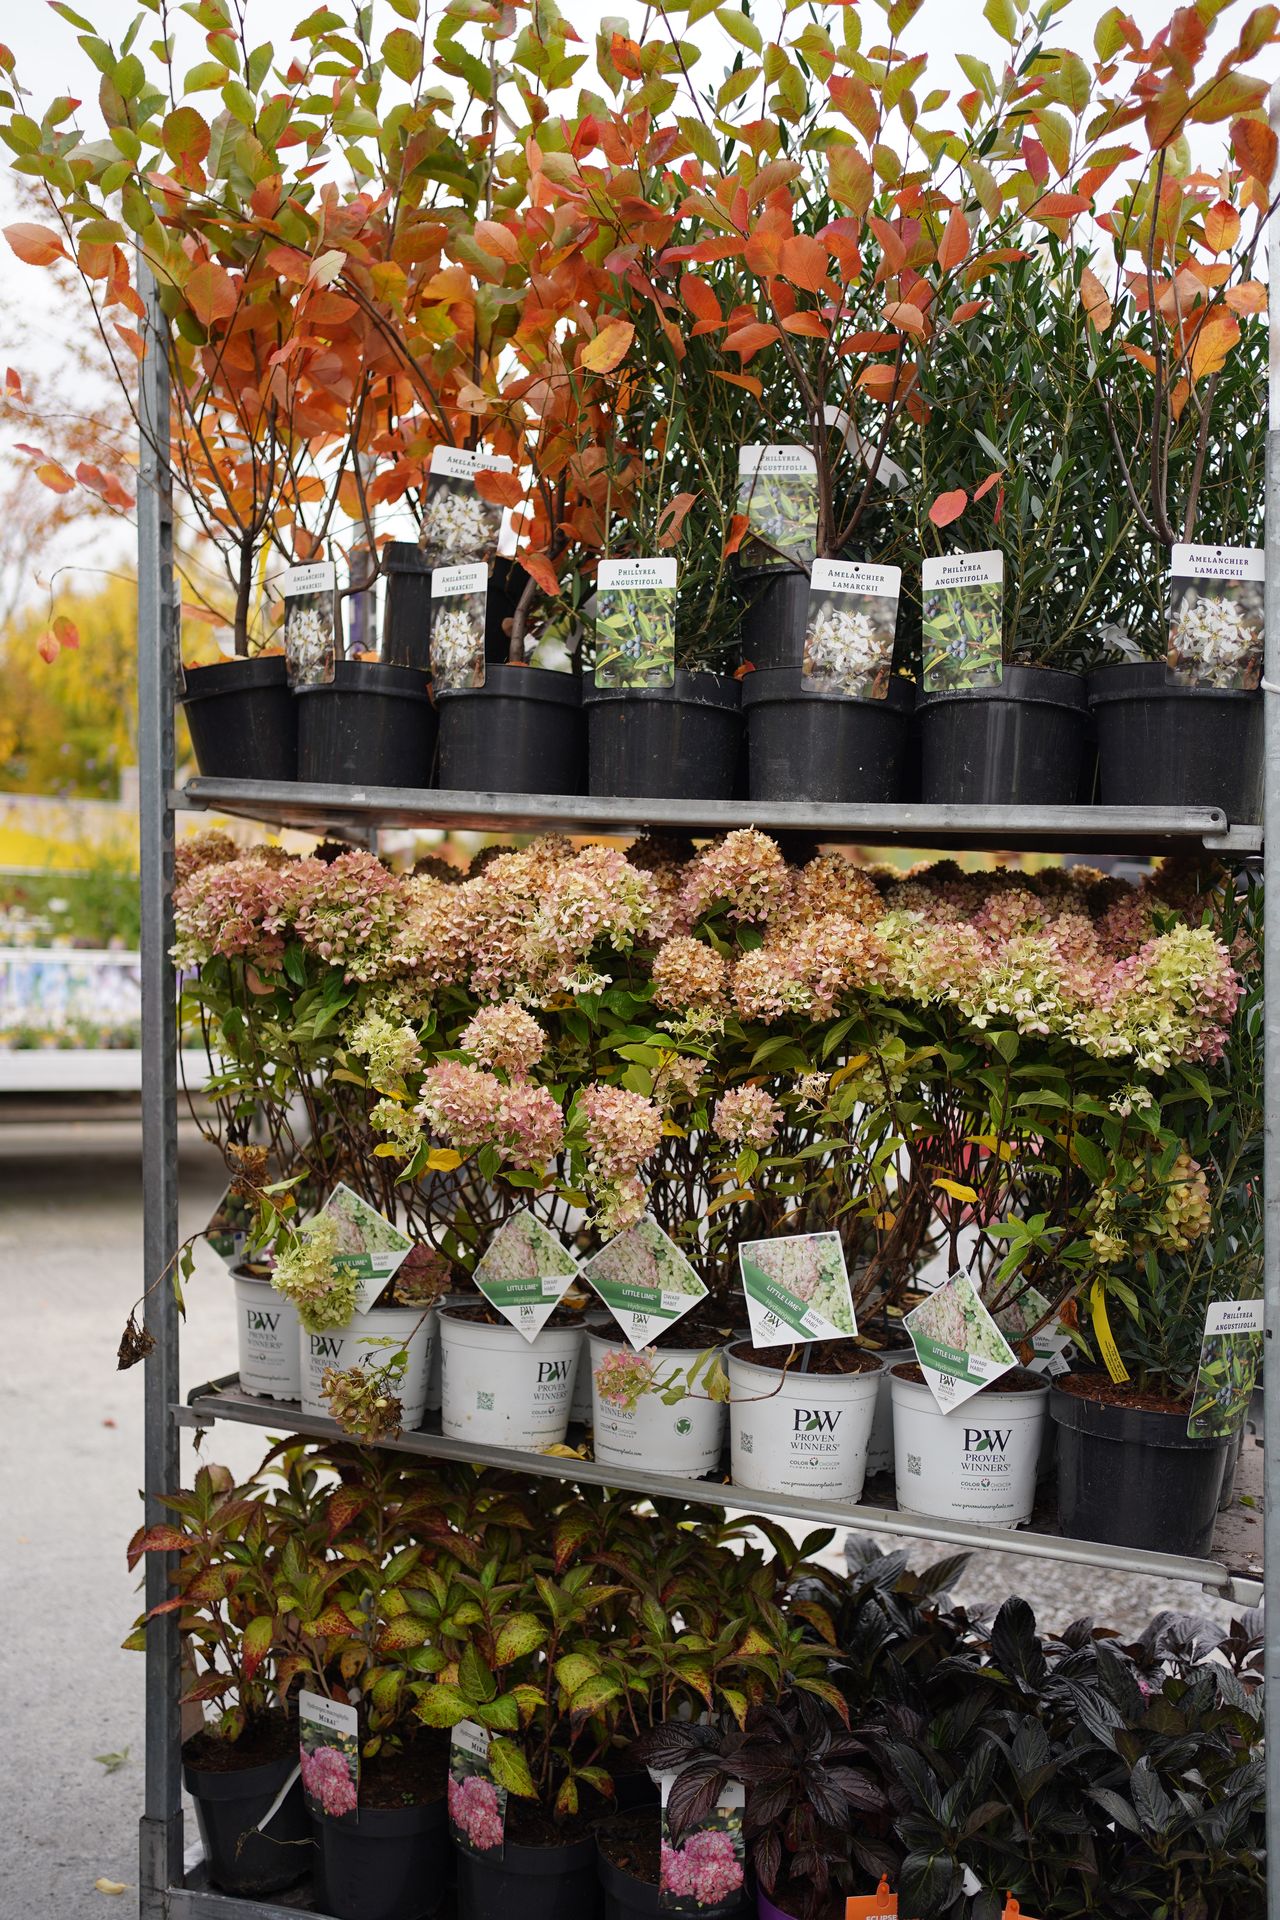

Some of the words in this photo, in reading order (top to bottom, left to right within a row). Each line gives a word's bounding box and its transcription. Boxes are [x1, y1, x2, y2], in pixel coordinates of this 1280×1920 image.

[1188, 554, 1249, 566] AMELANCHIER
[942, 564, 982, 574] PHILLYREA
[1194, 567, 1243, 576] LAMARCKII
[827, 569, 885, 582] AMELANCHIER
[935, 574, 989, 586] ANGUSTIFOLIA
[832, 581, 878, 592] LAMARCKII
[506, 1283, 525, 1292] LITTLE
[622, 1289, 641, 1298] LITTLE
[766, 1284, 785, 1300] LITTLE
[247, 1310, 281, 1331] PW
[1222, 1312, 1253, 1320] PHILLYREA
[1215, 1322, 1257, 1331] ANGUSTIFOLIA
[309, 1334, 344, 1359] PW
[932, 1346, 948, 1358] LITTLE
[536, 1360, 572, 1383] PW
[538, 1384, 567, 1392] PROVEN
[792, 1408, 843, 1433] PW
[795, 1433, 835, 1442] PROVEN
[962, 1428, 1013, 1452] PW
[965, 1453, 1006, 1463] PROVEN
[471, 1742, 487, 1755] MIRA
